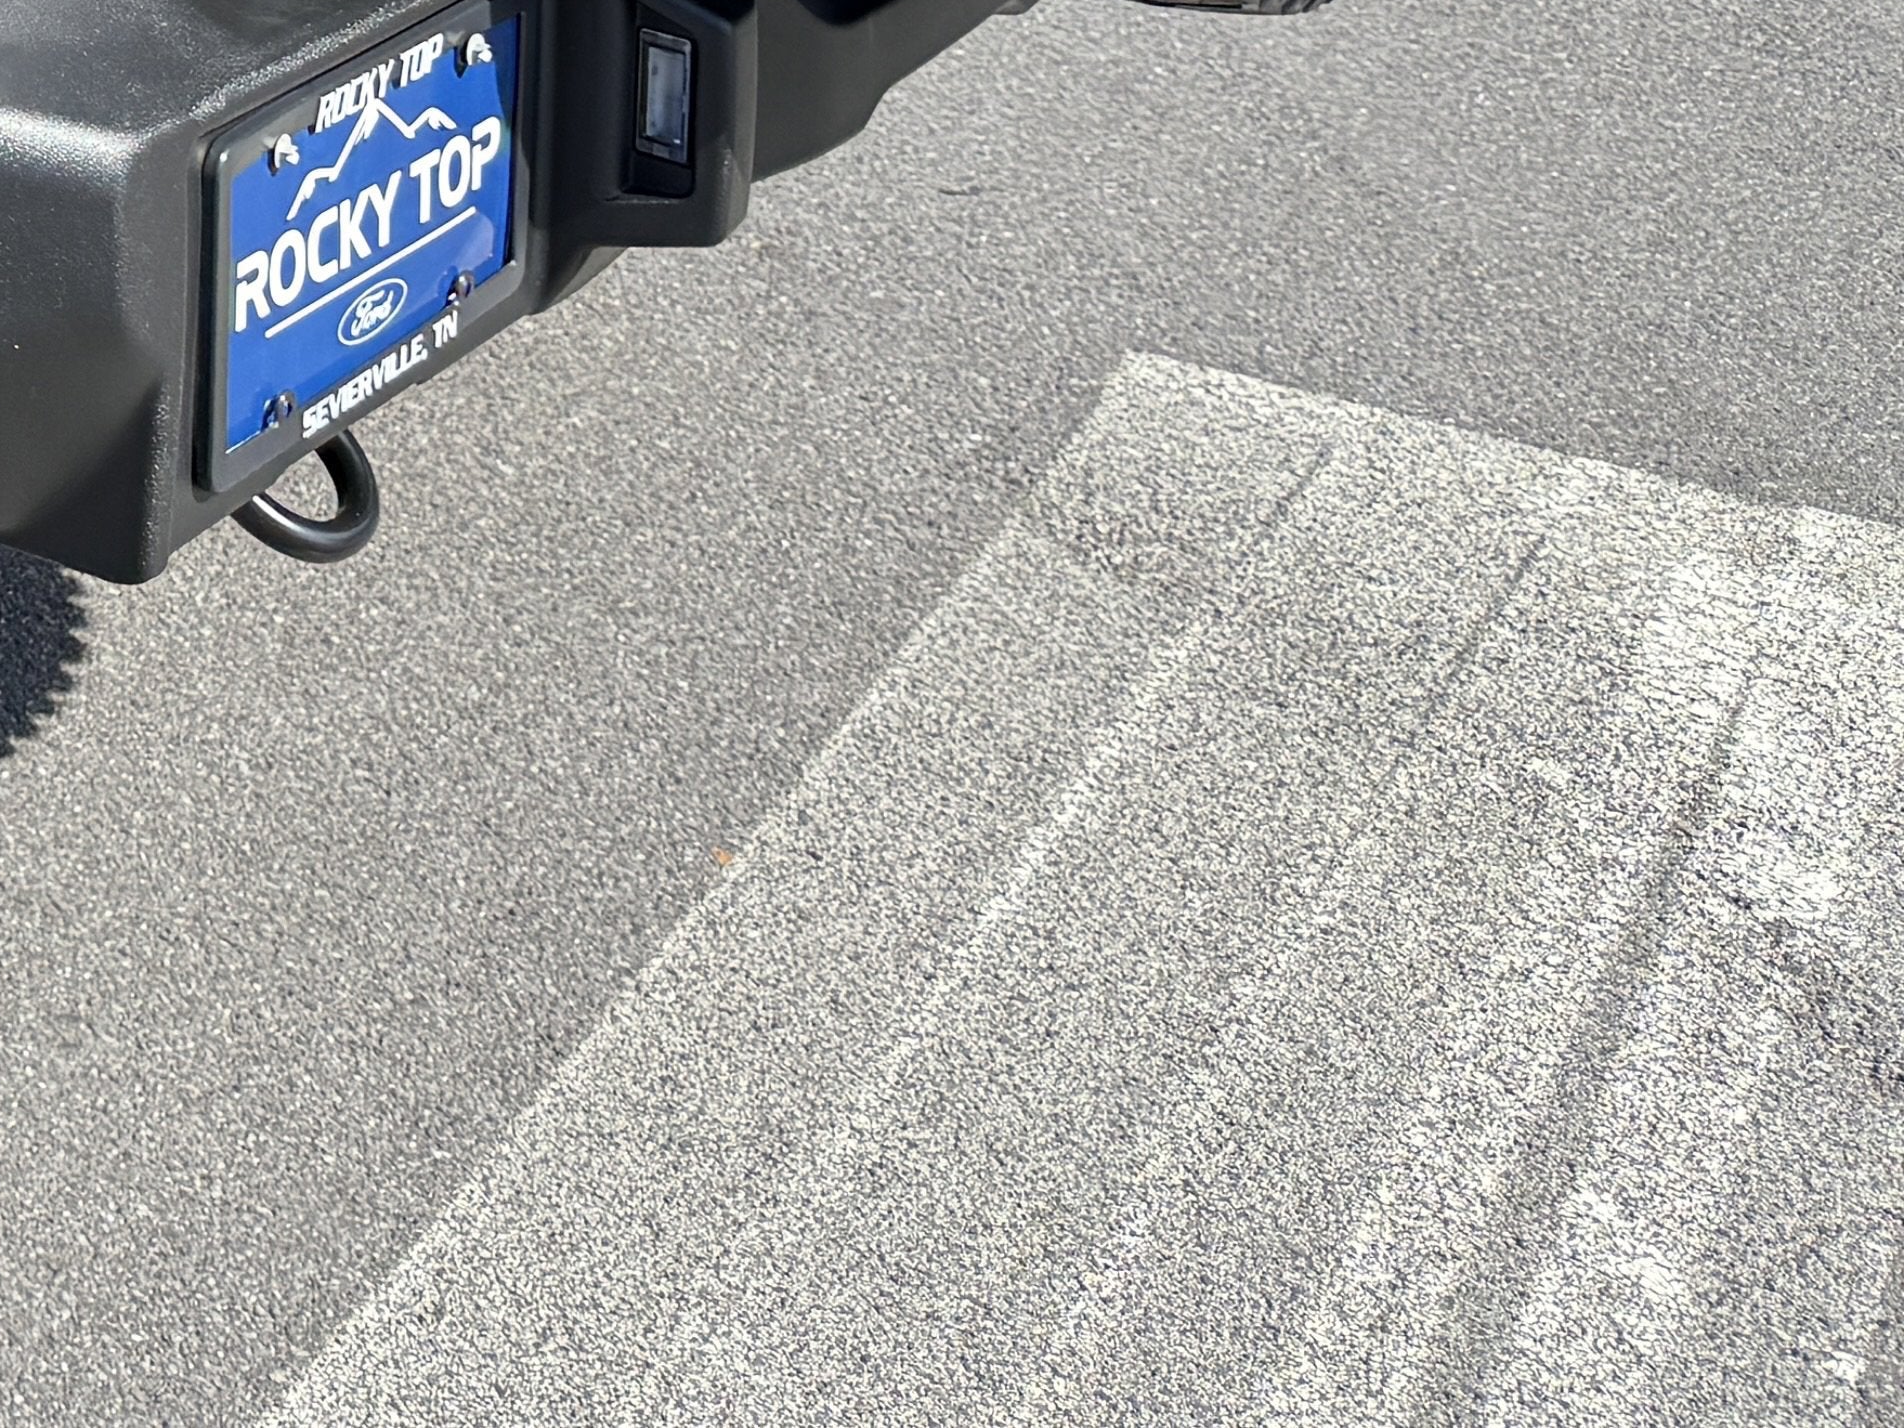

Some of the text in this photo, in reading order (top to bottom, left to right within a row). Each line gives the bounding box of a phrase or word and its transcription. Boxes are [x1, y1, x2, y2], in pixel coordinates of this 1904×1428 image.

[314, 32, 444, 134] ROCKY TOP
[234, 116, 501, 333] ROCKY TOP
[351, 289, 395, 338] Ford
[302, 309, 459, 439] SEVIERVILLE, TN
